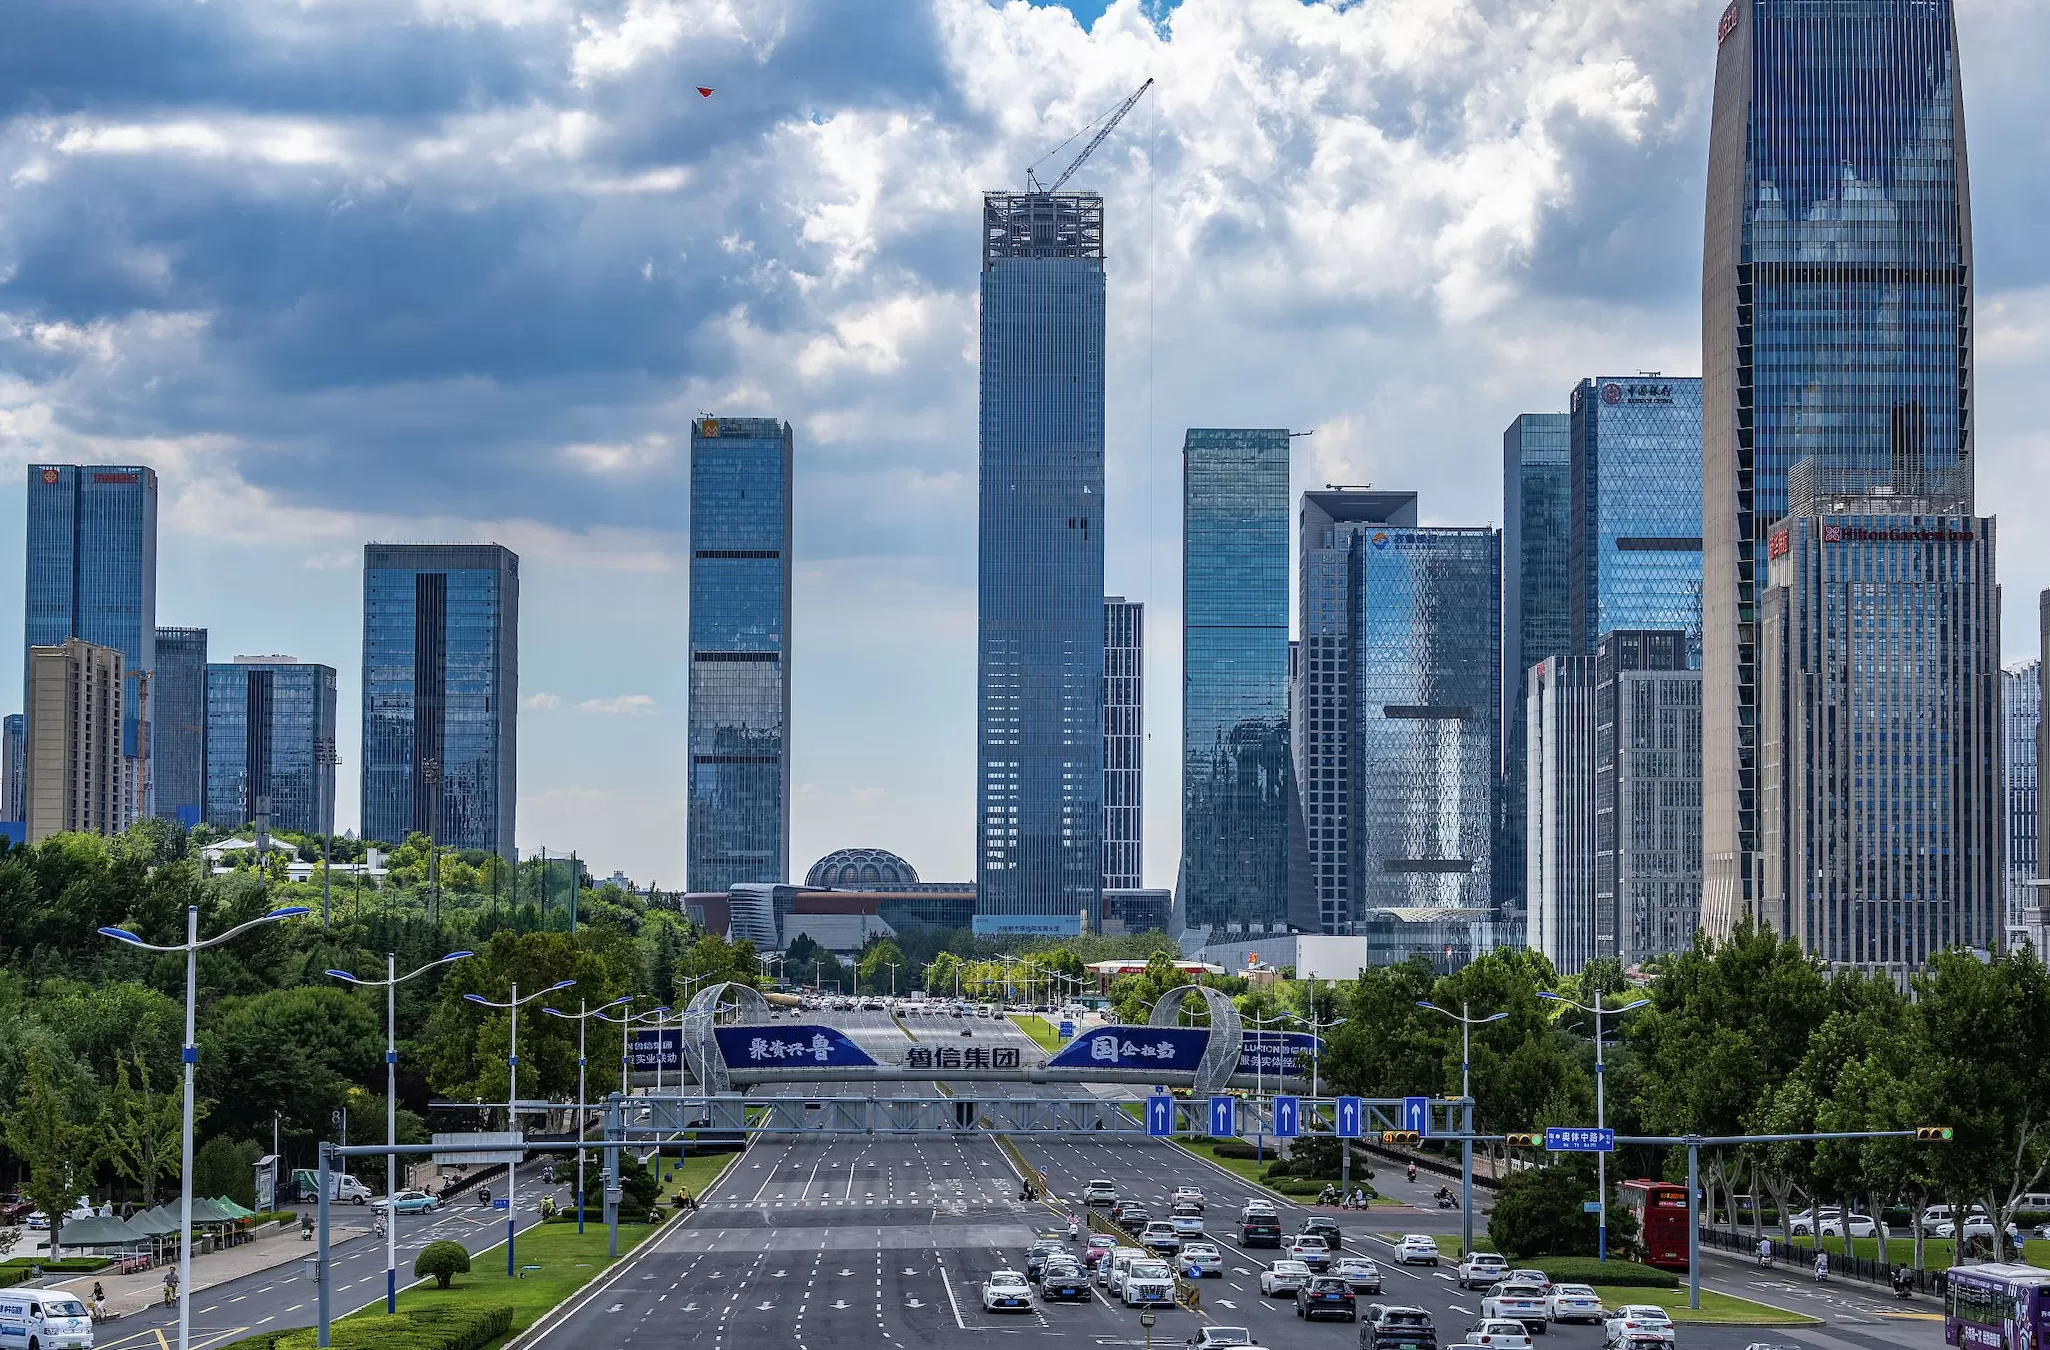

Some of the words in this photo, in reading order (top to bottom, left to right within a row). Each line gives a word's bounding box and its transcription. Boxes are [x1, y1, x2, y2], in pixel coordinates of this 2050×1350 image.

[1841, 526, 1888, 541] Hilton
[1889, 526, 1945, 542] Garden
[1947, 528, 1974, 541] Inn
[748, 1033, 835, 1061] 聚资兴鲁
[905, 1047, 1020, 1069] 鲁信集团
[1091, 1035, 1176, 1063] 国企担当
[1562, 1132, 1598, 1142] 奥体中路
